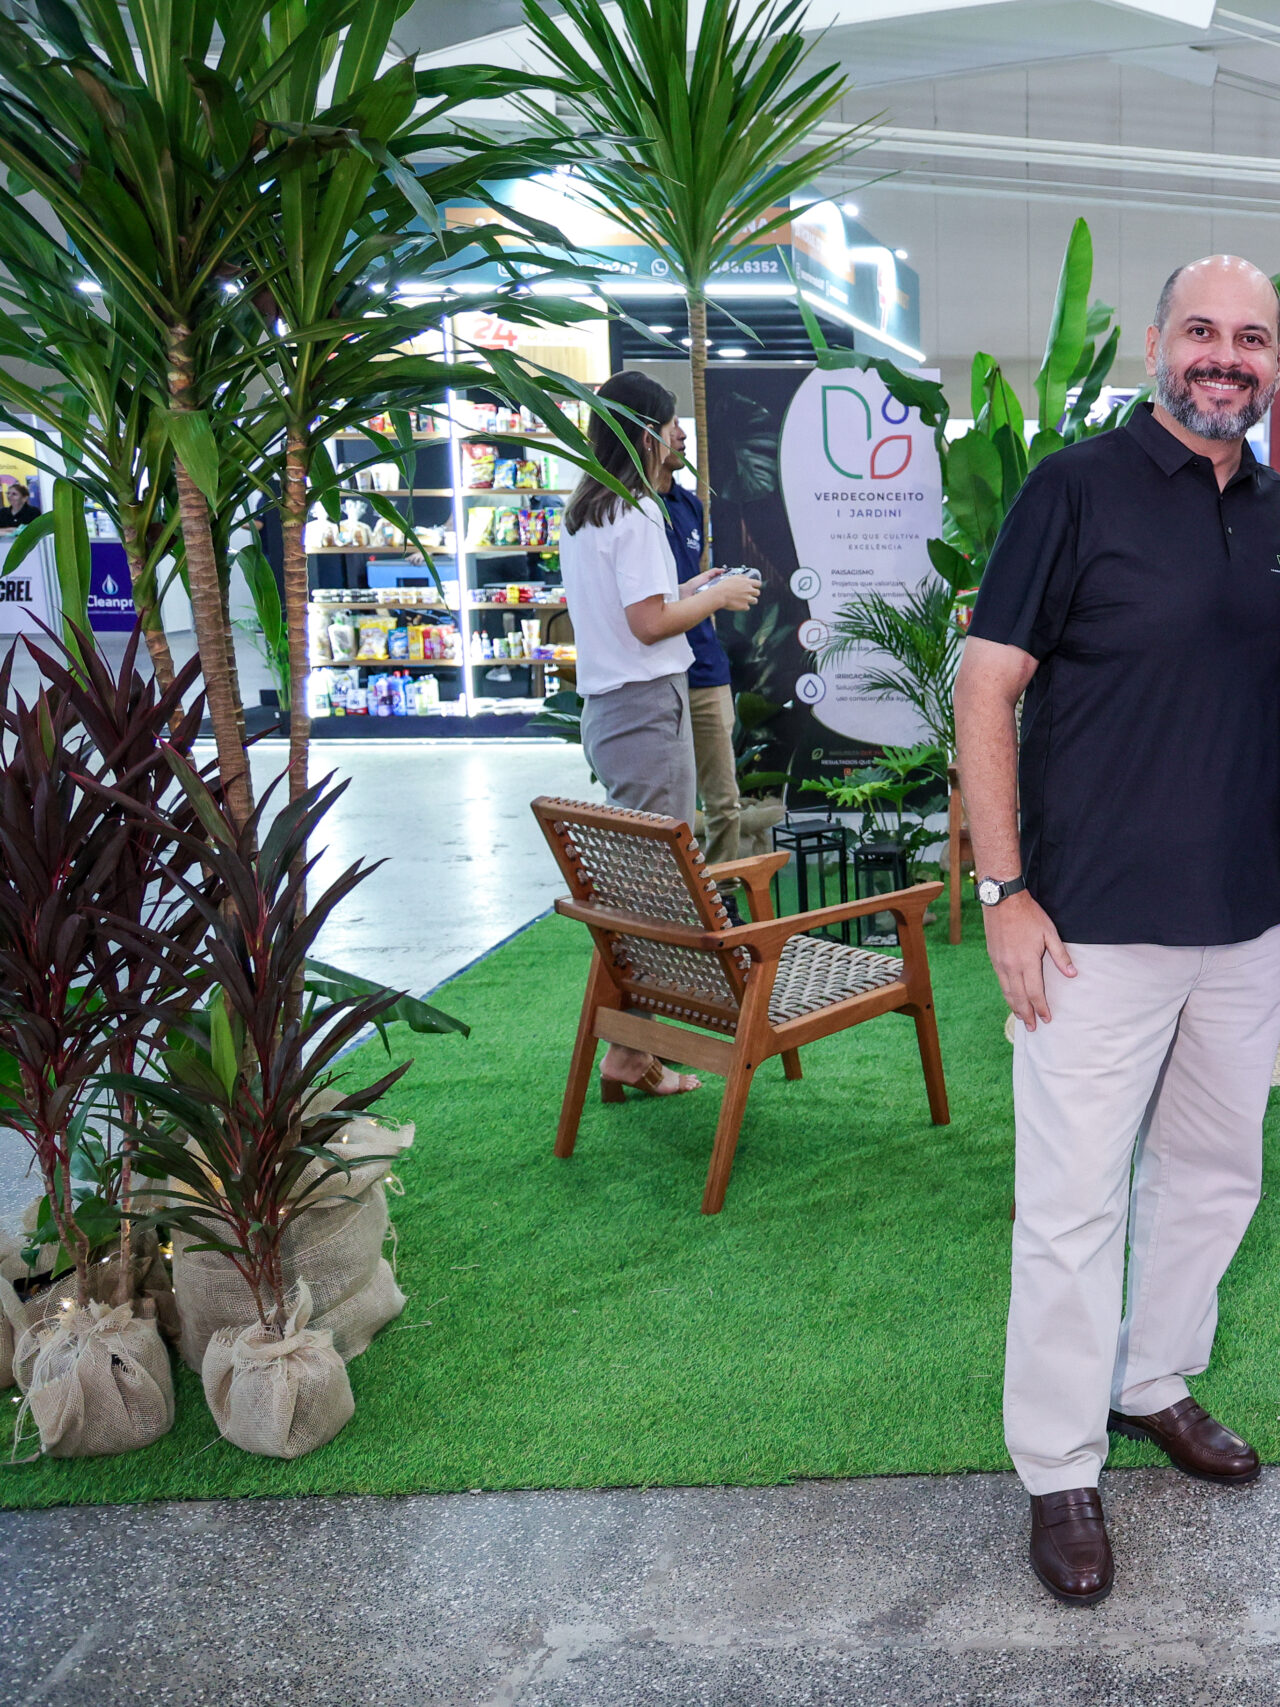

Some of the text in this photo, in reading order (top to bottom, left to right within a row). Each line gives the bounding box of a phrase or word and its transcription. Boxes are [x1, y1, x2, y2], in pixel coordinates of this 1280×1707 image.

[814, 492, 924, 501] VERDECONCEITO
[849, 509, 902, 518] JARDINI
[86, 594, 134, 610] Cleanpr
